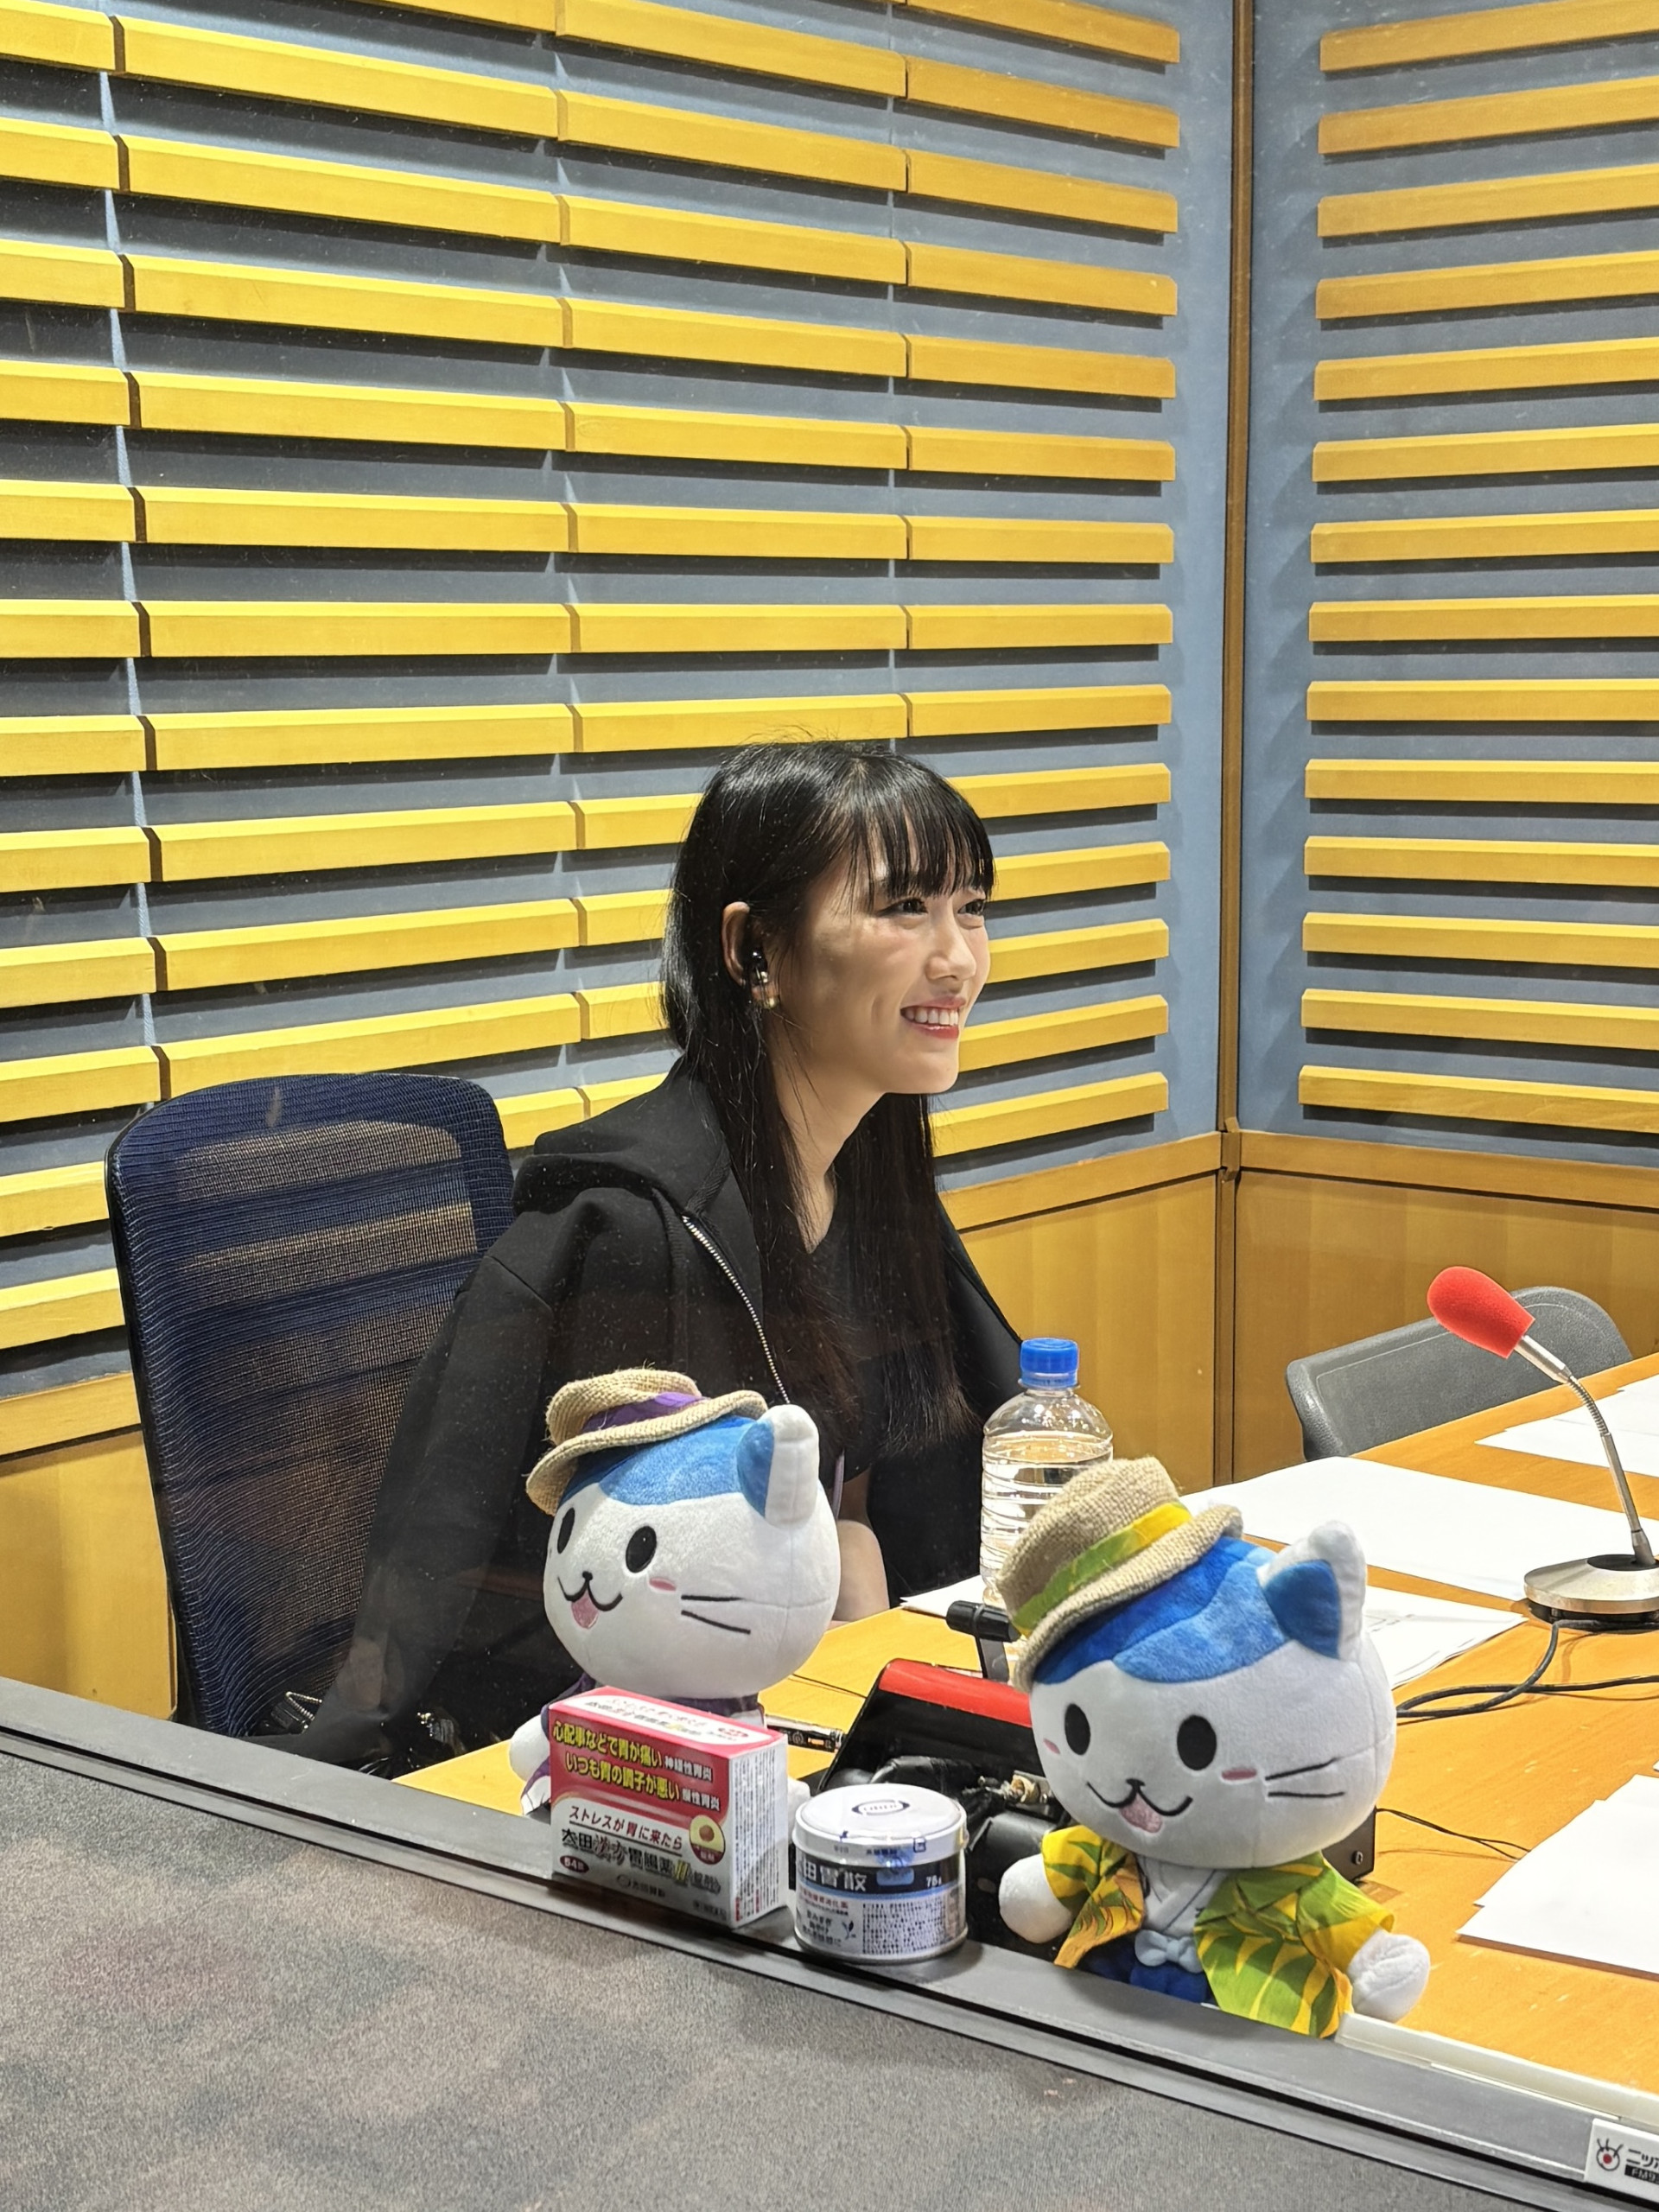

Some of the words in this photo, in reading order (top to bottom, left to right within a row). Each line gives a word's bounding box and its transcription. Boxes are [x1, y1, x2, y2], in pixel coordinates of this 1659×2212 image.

[553, 1720, 662, 1768] 心配事などで胃が痛い
[566, 1751, 679, 1800] いつも胃の調子が悪い
[569, 1805, 683, 1850] ストレスが胃に来たら
[1631, 2167, 1659, 2183] FM9
